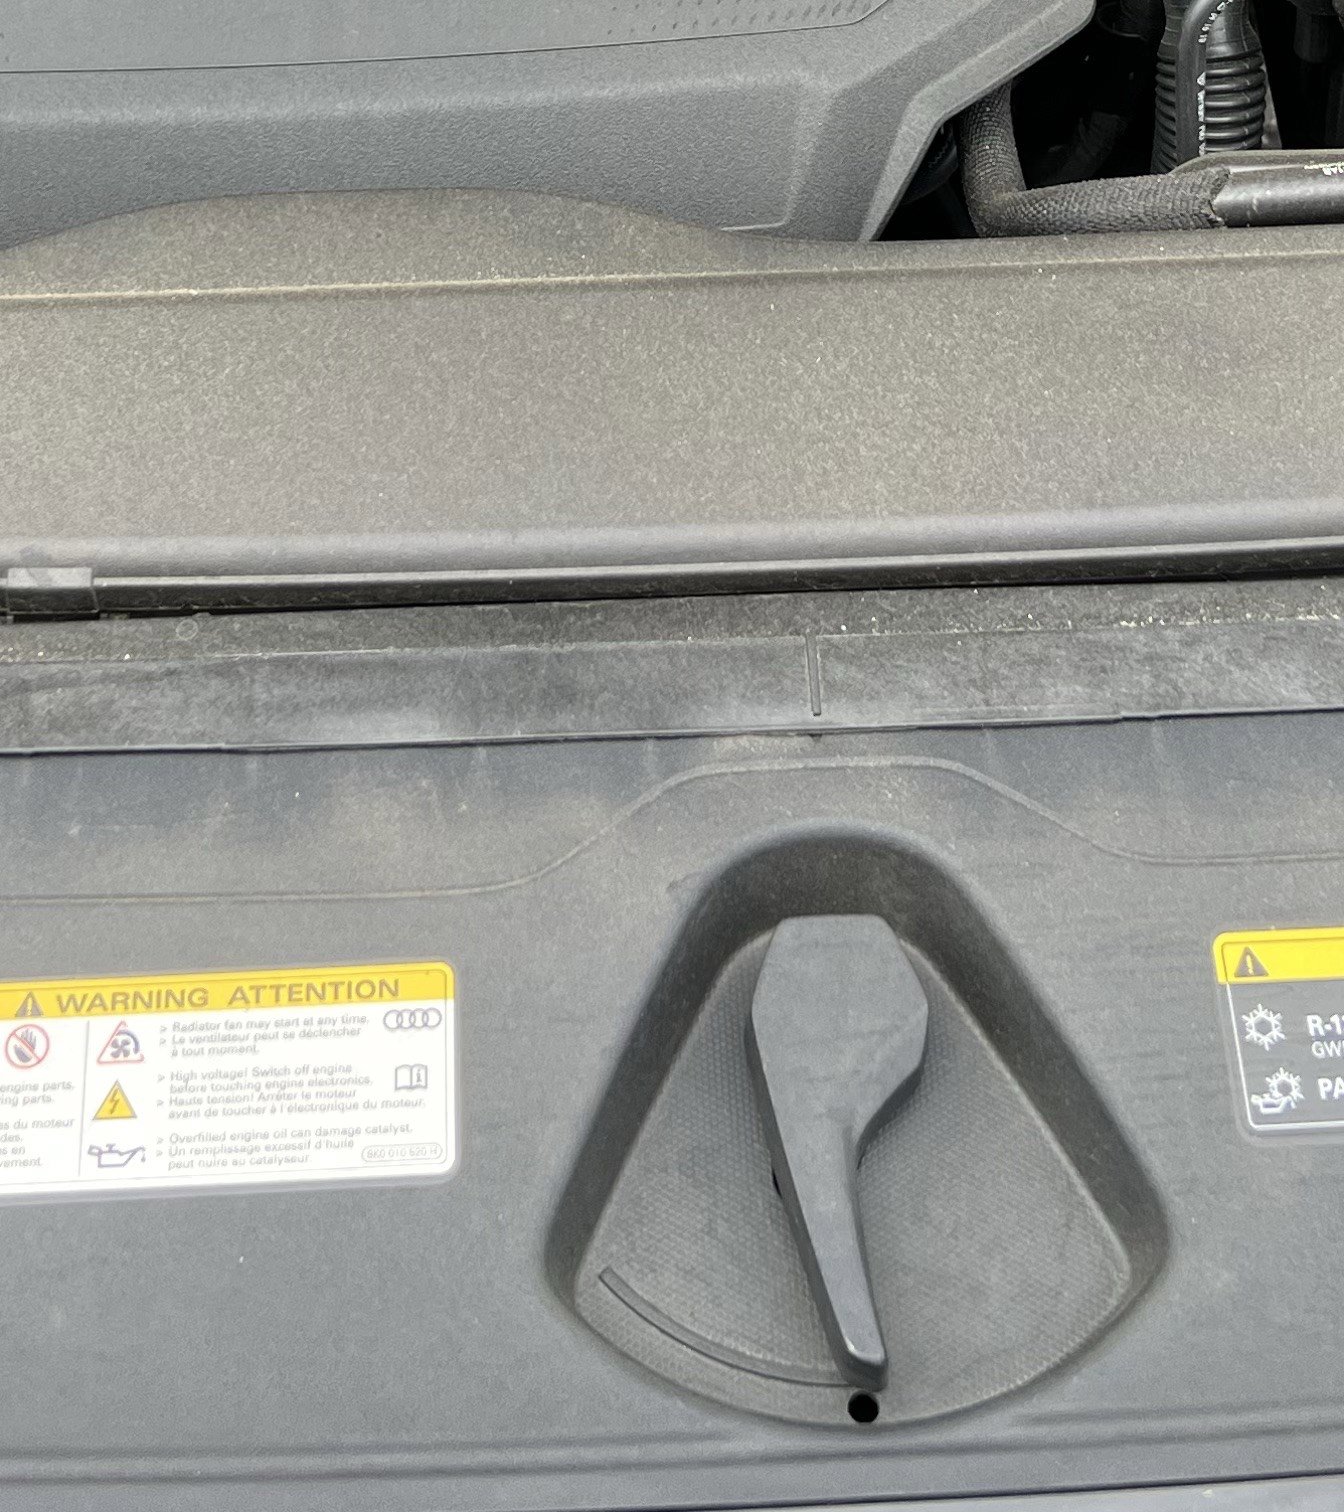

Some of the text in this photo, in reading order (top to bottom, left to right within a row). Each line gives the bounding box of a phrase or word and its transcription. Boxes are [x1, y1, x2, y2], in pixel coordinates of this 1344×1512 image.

[56, 979, 400, 1014] WARNING ATTENTION
[172, 1020, 221, 1032] Radiator
[224, 1019, 242, 1030] fan
[246, 1020, 271, 1030] may
[274, 1017, 300, 1028] start
[303, 1016, 313, 1026] at
[317, 1015, 337, 1026] any
[172, 1027, 362, 1044] Le ventilateur peut se déclencher
[181, 1046, 205, 1057] tout
[170, 1064, 353, 1084] High voltage! Switch off engine
[170, 1083, 207, 1094] before
[211, 1081, 261, 1093] touching
[264, 1079, 307, 1090] engine
[170, 1095, 203, 1106] Haute
[207, 1093, 254, 1105] tension!
[301, 1090, 312, 1100] le
[315, 1090, 357, 1100] moteur
[169, 1108, 201, 1120] avant
[204, 1106, 219, 1118] de
[222, 1104, 267, 1116] toucher
[362, 1099, 378, 1109] du
[13, 1118, 28, 1129] du
[31, 1118, 75, 1128] moteur
[169, 1131, 227, 1144] Overfilled
[229, 1129, 270, 1142] engine
[273, 1129, 288, 1139] oil
[290, 1128, 312, 1138] can
[315, 1125, 362, 1138] damage
[11, 1147, 25, 1156] en
[168, 1145, 186, 1157] Un
[189, 1143, 261, 1157] remplissage
[264, 1139, 312, 1152] excessif
[168, 1159, 194, 1171] peut
[198, 1157, 228, 1168] nuire
[231, 1158, 246, 1167] au
